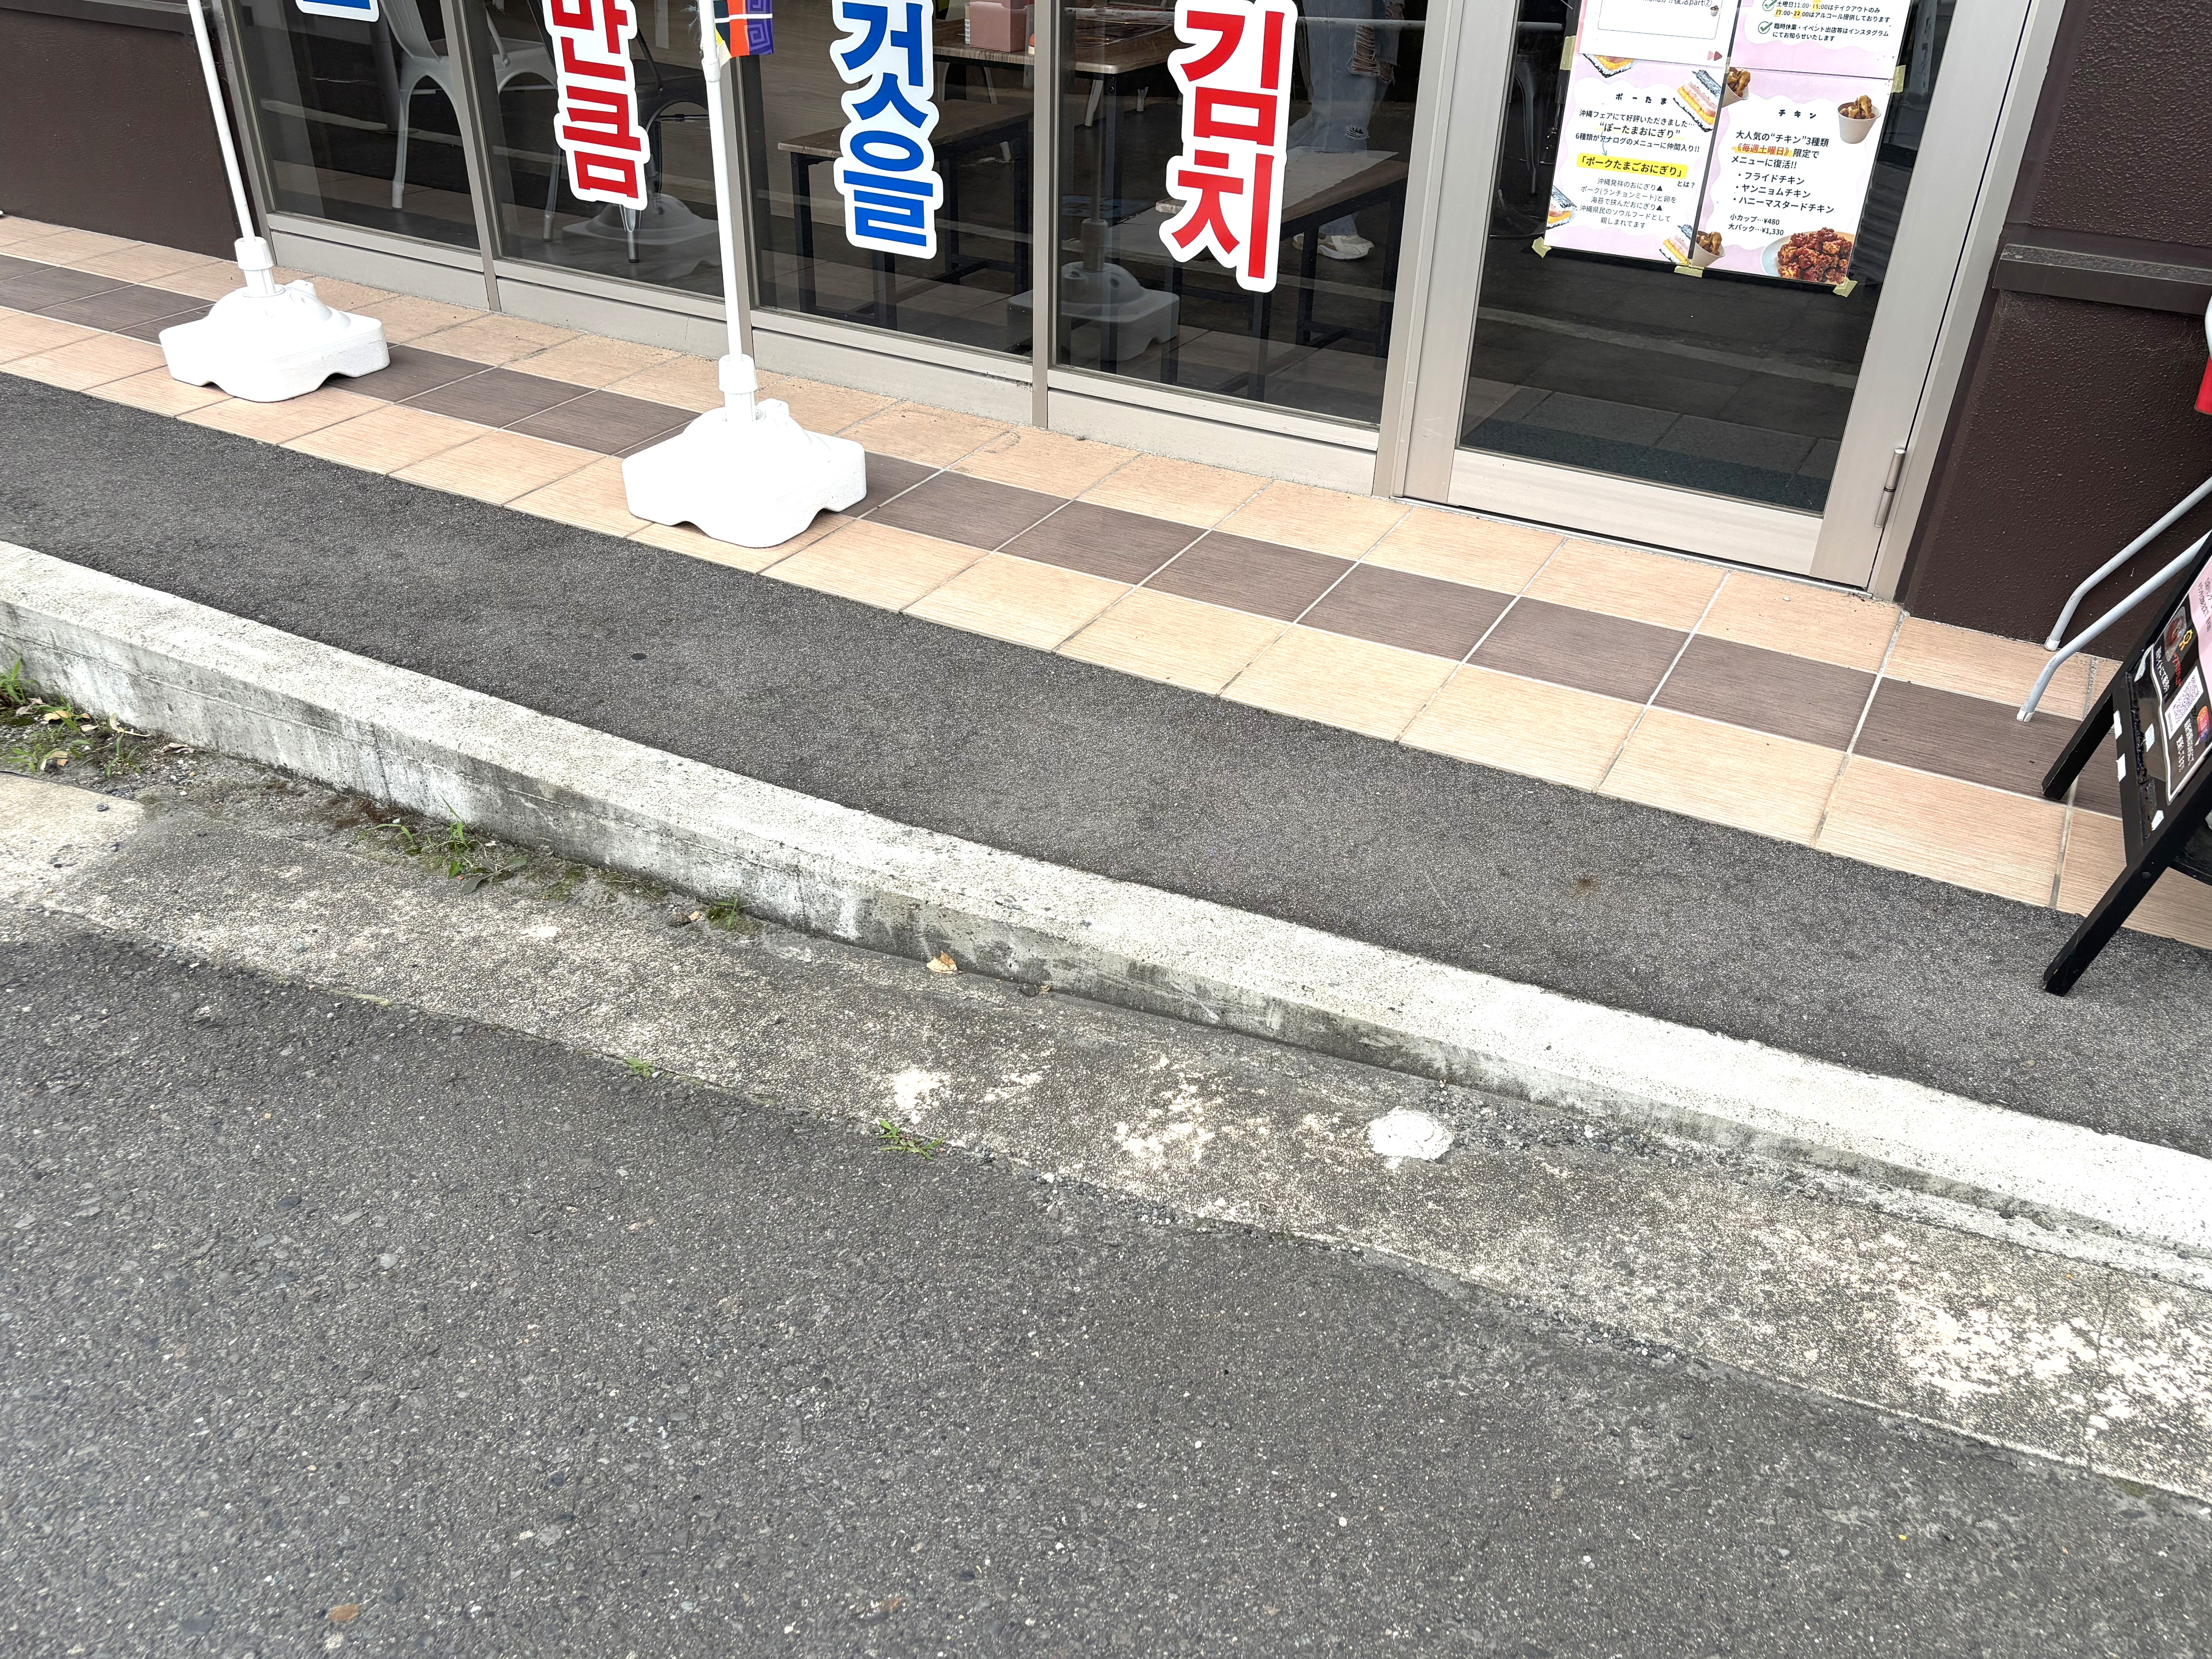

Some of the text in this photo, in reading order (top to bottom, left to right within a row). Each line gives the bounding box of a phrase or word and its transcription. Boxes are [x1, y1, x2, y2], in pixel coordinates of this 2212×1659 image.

[1772, 32, 1835, 41] にてお知らせいたします
[551, 0, 641, 199] 만큼
[1778, 109, 1816, 119] チキン
[841, 2, 933, 247] 것을
[1171, 11, 1285, 279] 김치
[1582, 156, 1682, 177] 「ポークたまごおにぎり」
[1580, 204, 1671, 222] 沖縄県民のソウルフードとして
[1601, 217, 1646, 228] 親しまれてます
